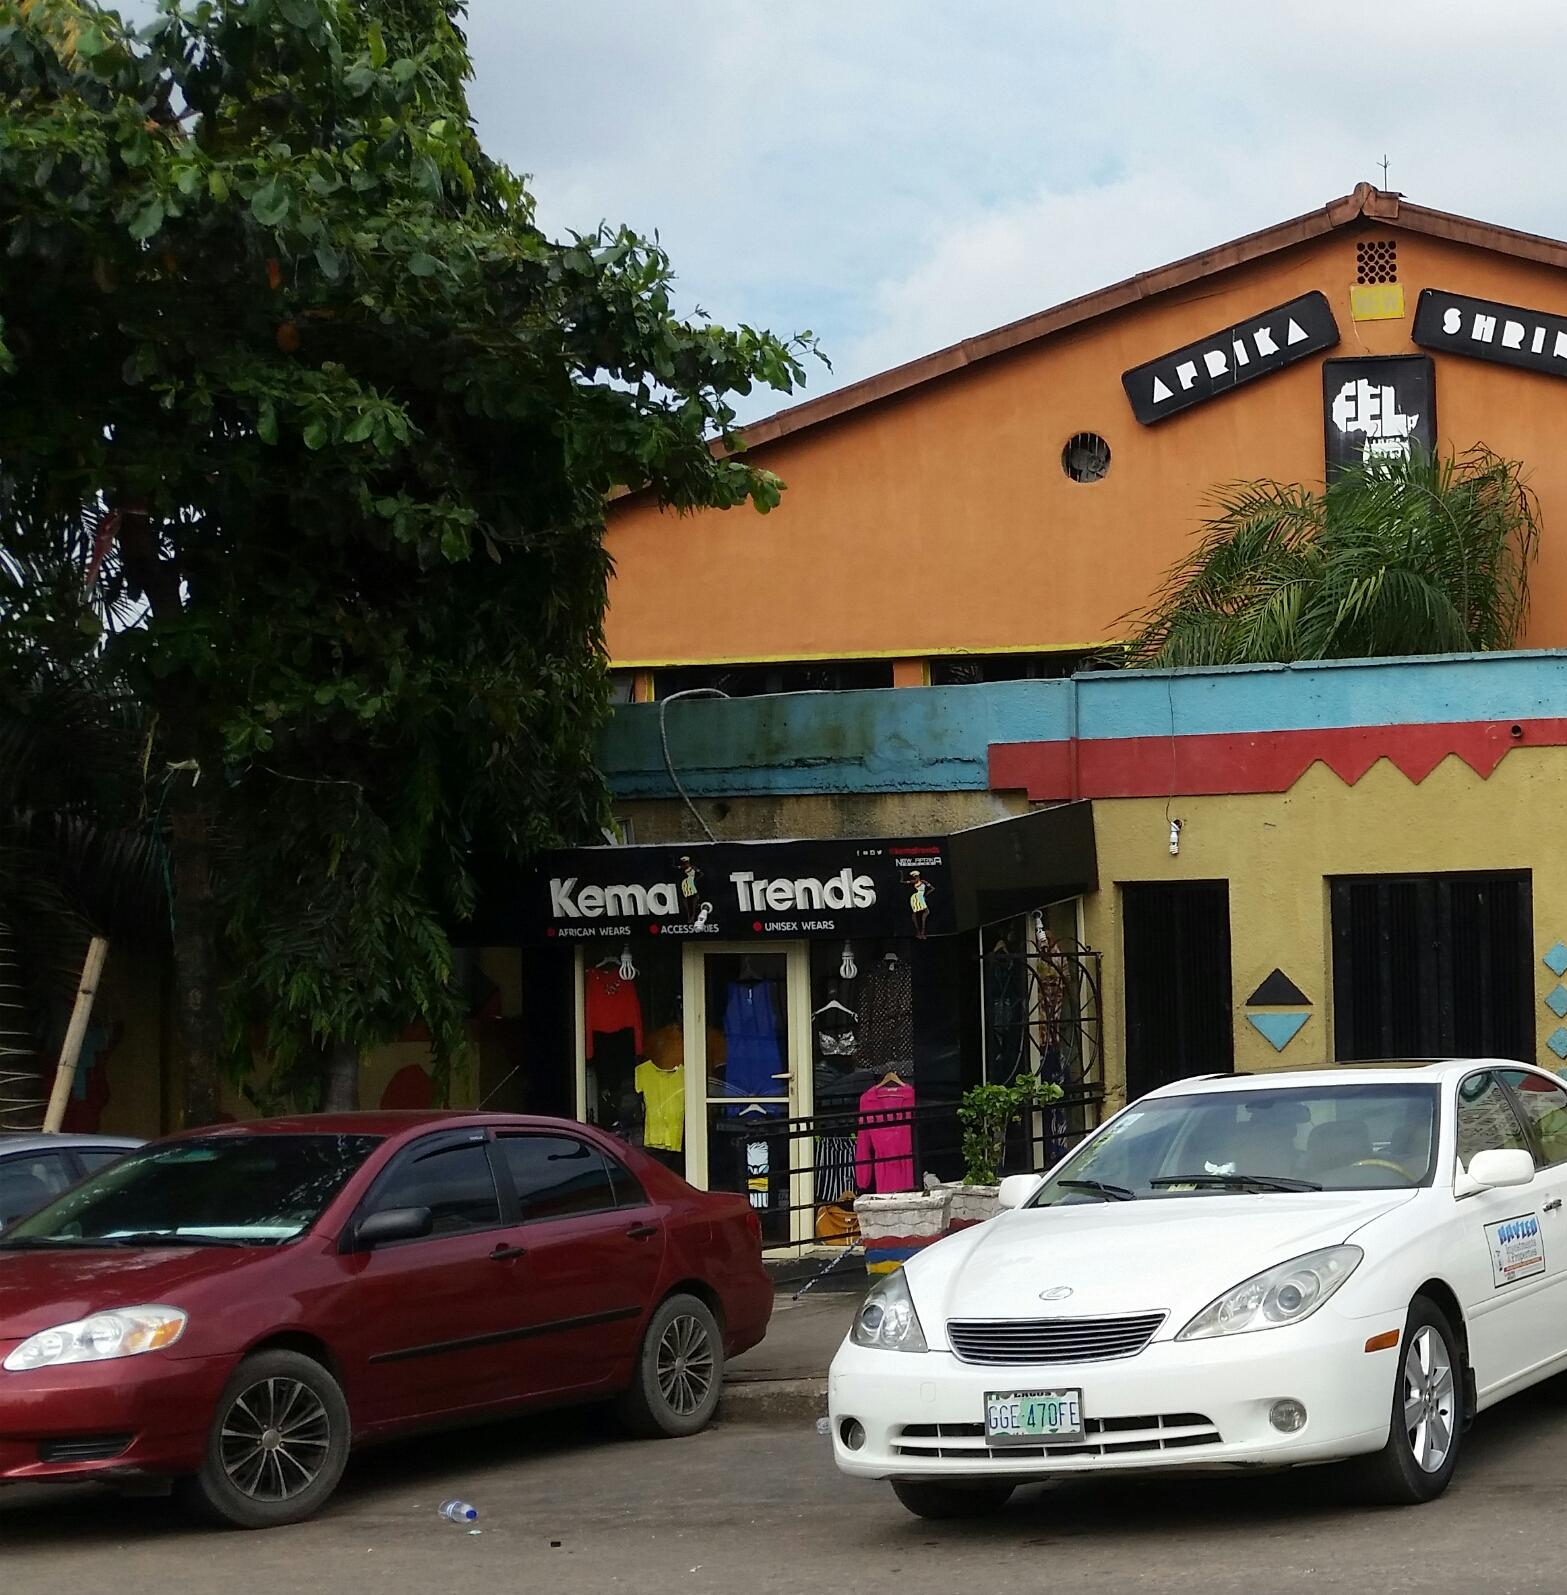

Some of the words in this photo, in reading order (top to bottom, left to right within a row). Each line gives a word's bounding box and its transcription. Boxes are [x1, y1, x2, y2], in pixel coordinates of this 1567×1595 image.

[1153, 317, 1309, 404] AFRIKA
[550, 877, 680, 918] Kema
[730, 868, 876, 912] Trends
[558, 927, 596, 937] AFRICAN
[600, 926, 631, 936] WEARS
[765, 922, 798, 932] UNISEX
[801, 920, 835, 931] WEARS
